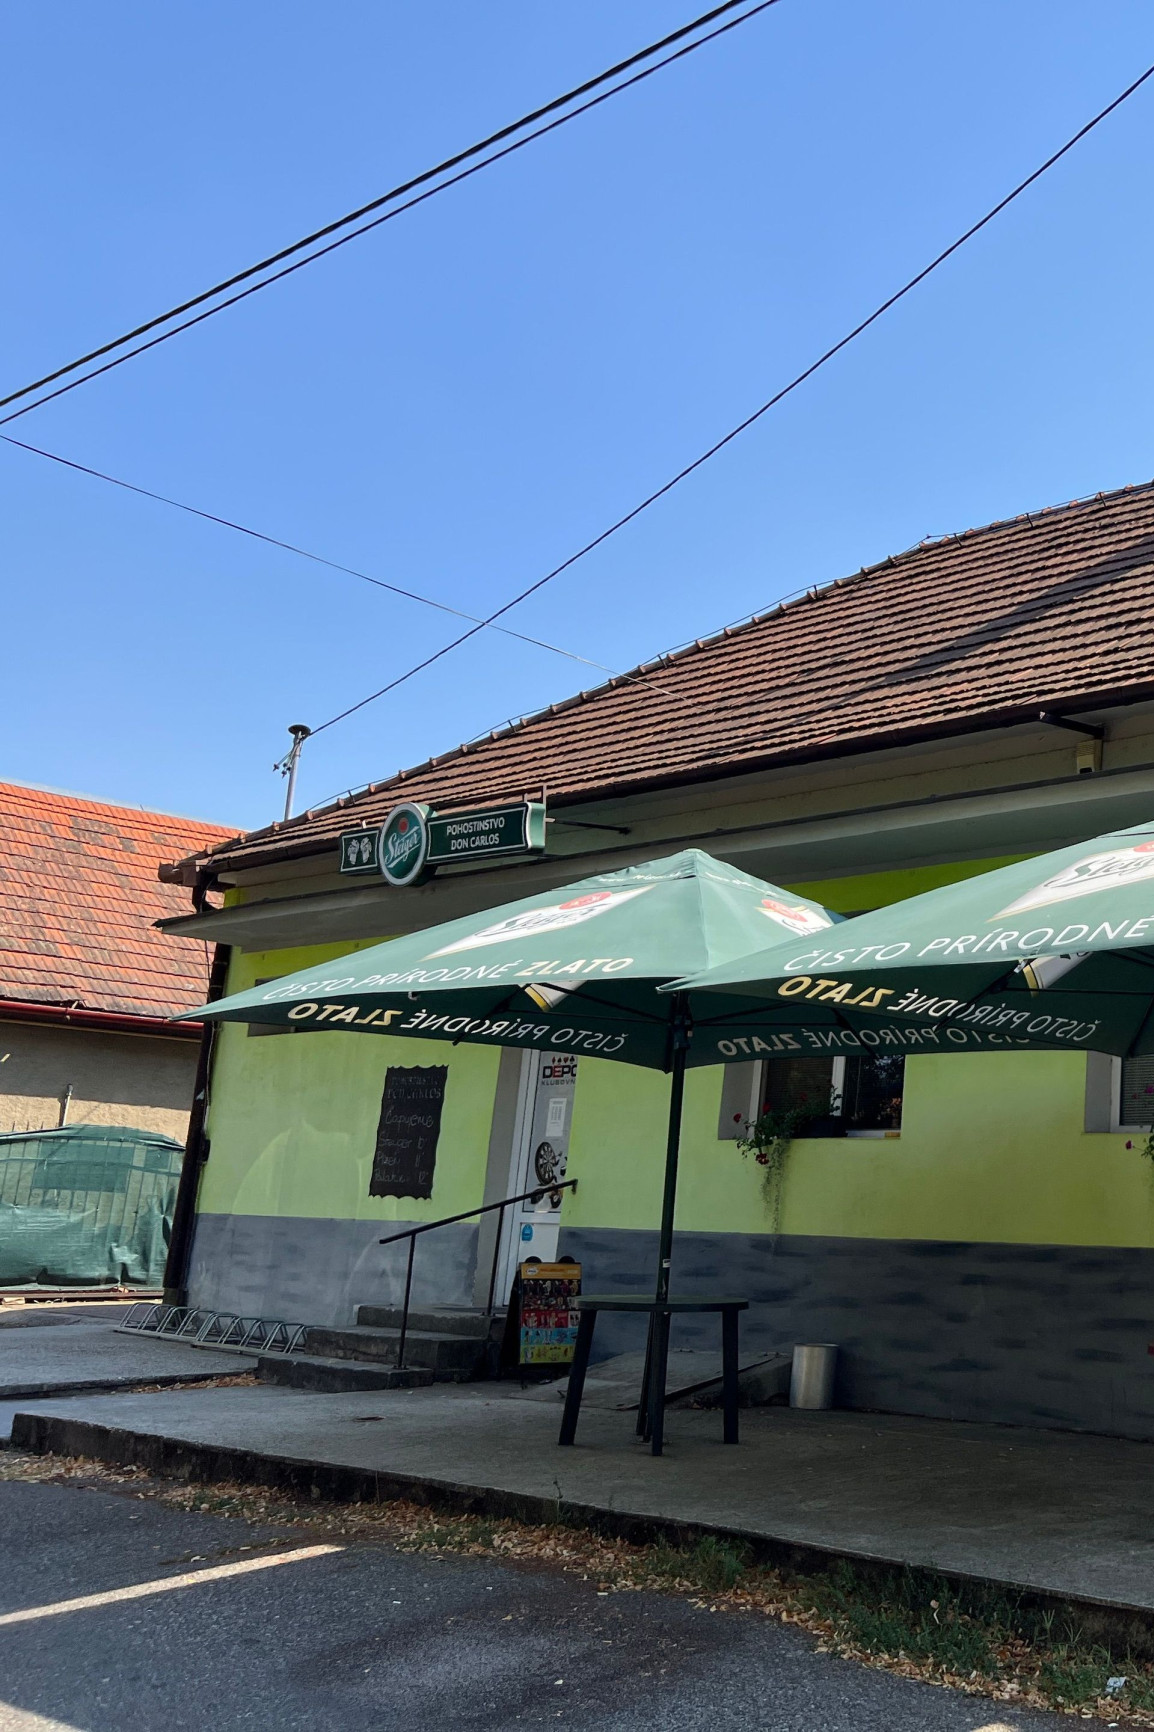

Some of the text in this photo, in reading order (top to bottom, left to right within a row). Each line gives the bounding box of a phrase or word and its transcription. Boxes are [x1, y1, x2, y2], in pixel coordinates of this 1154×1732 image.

[446, 816, 505, 836] POHOSTINSTVO
[451, 833, 500, 850] DON CARLOS
[783, 941, 911, 973] ČISTO
[262, 957, 634, 1001] ČISTO PRÍRODNÉ ZLATO
